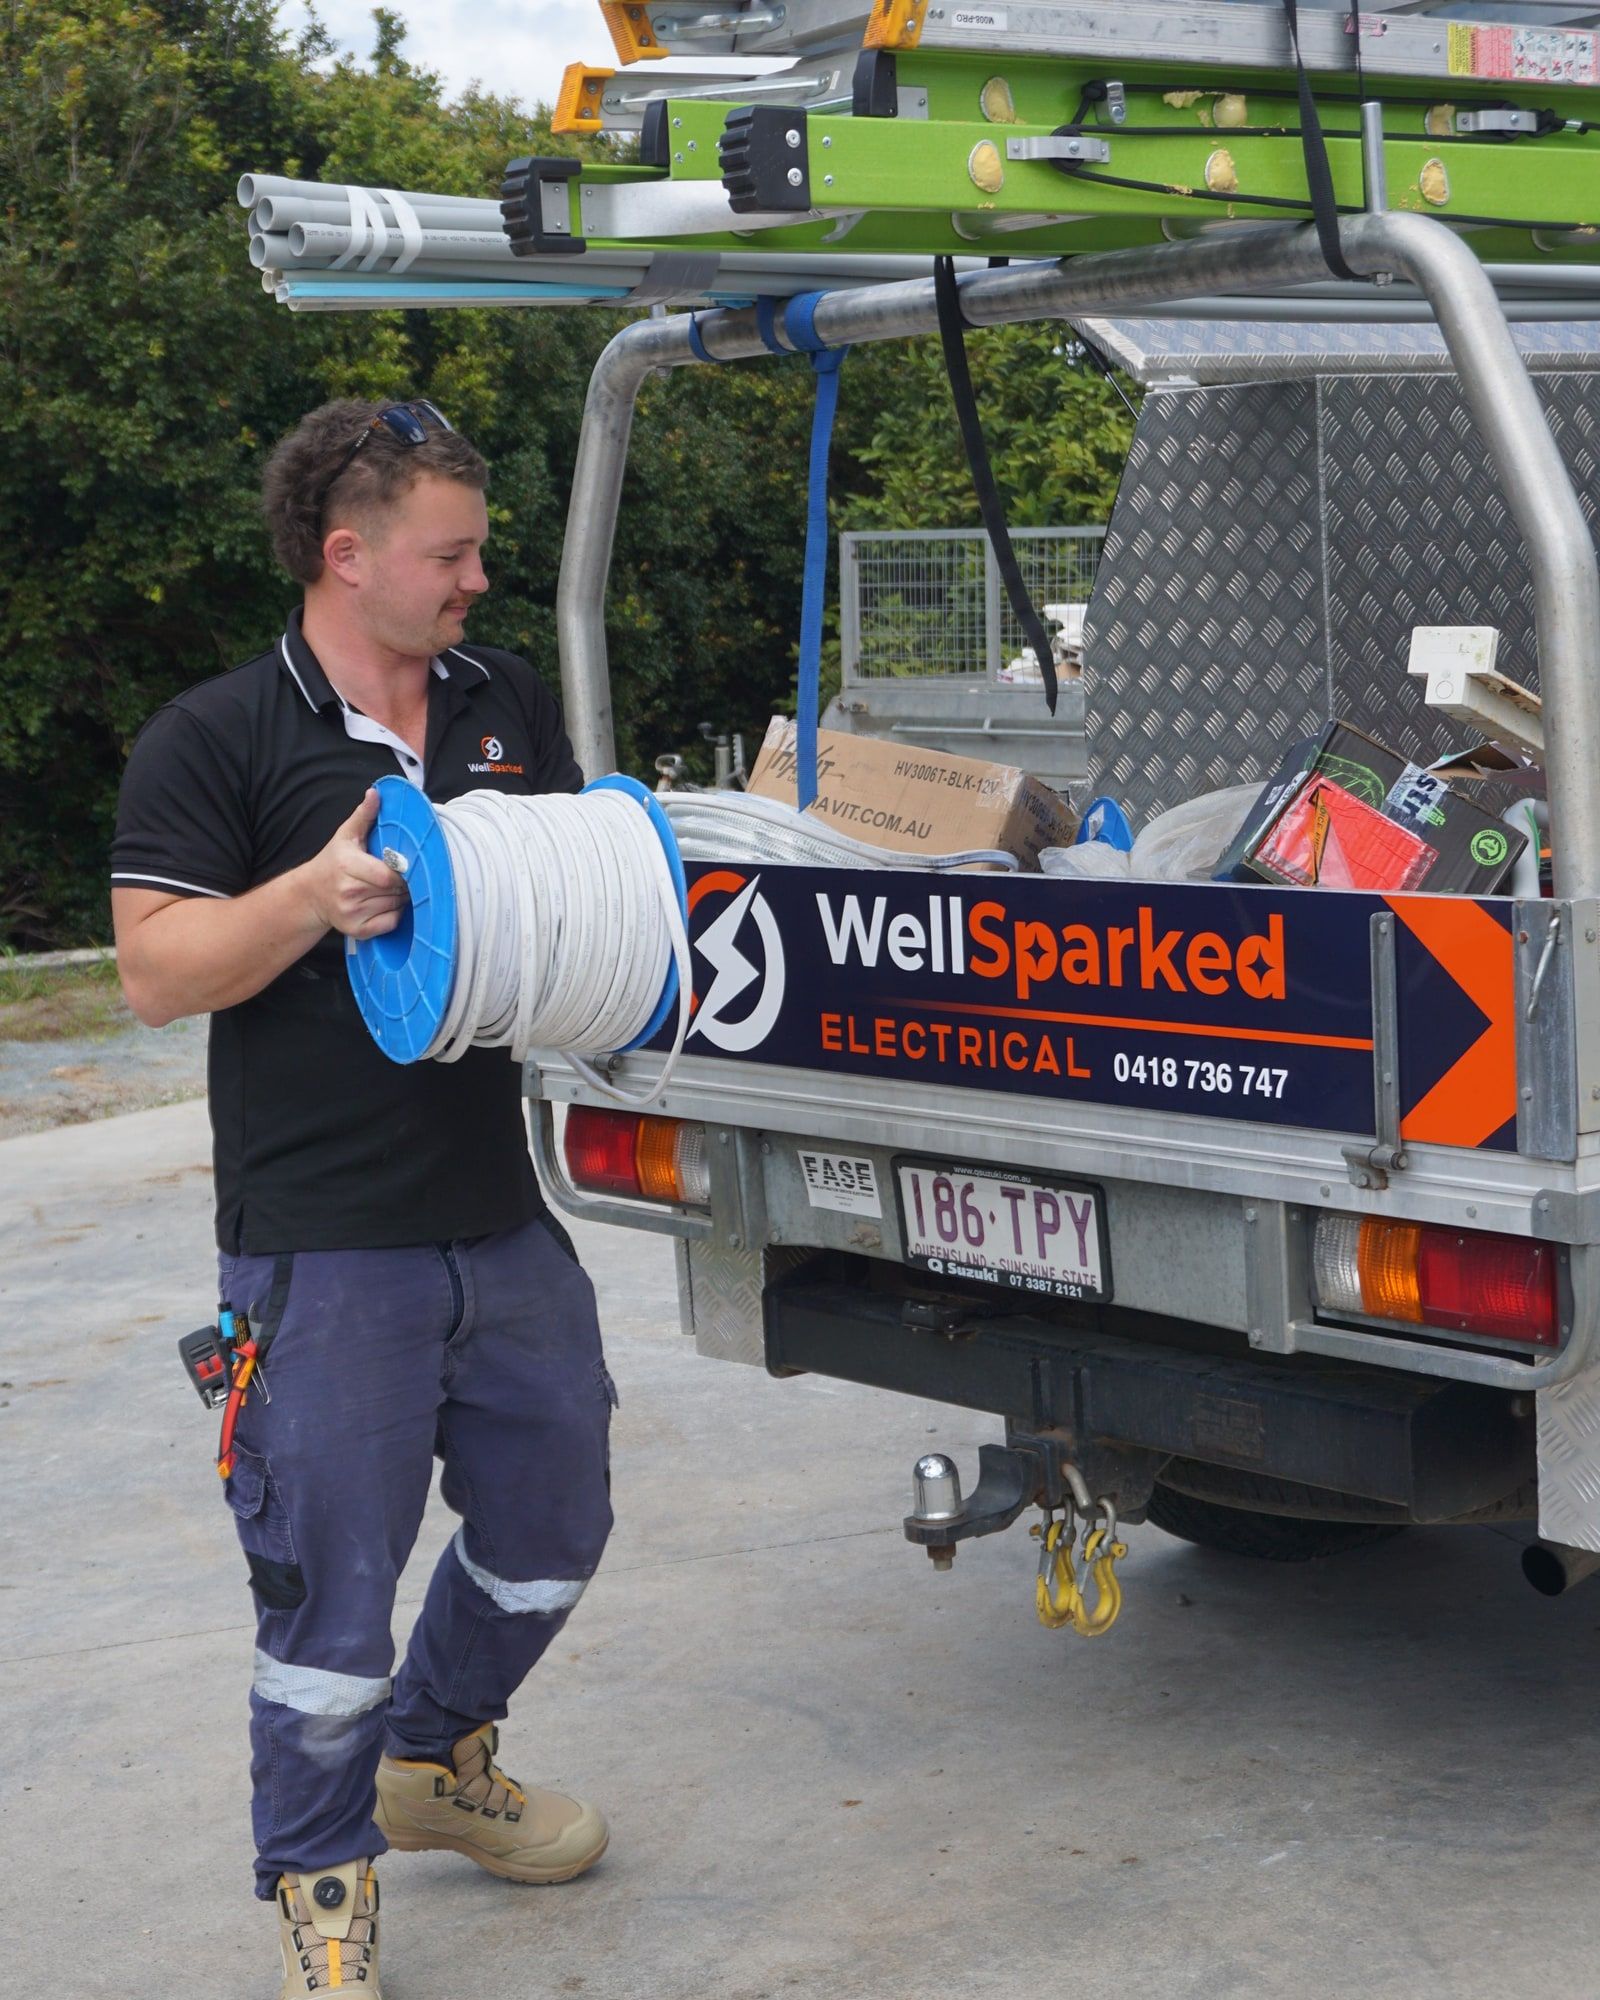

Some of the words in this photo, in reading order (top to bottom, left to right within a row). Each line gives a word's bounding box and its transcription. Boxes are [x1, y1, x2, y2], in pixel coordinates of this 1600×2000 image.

[467, 763, 524, 775] WellSparked
[894, 760, 1000, 795] HV3006T-BLK-12V
[815, 892, 1286, 1000] WellSparked
[820, 1012, 1092, 1079] ELECTRICAL
[1113, 1052, 1178, 1088] 0418
[1184, 1059, 1233, 1094] 736
[1238, 1065, 1289, 1099] 747
[803, 1156, 874, 1192] FASE
[953, 1166, 1031, 1183] www.qsuzuki.com.au
[914, 1243, 987, 1267] QUEENSLAND
[999, 1258, 1056, 1280] SUNSHINE
[1062, 1269, 1097, 1287] STATE
[927, 1258, 944, 1274] Q
[947, 1262, 999, 1283] Suzuki
[1009, 1274, 1022, 1287] 07
[1026, 1277, 1052, 1293] 3387
[1055, 1282, 1083, 1298] 2121
